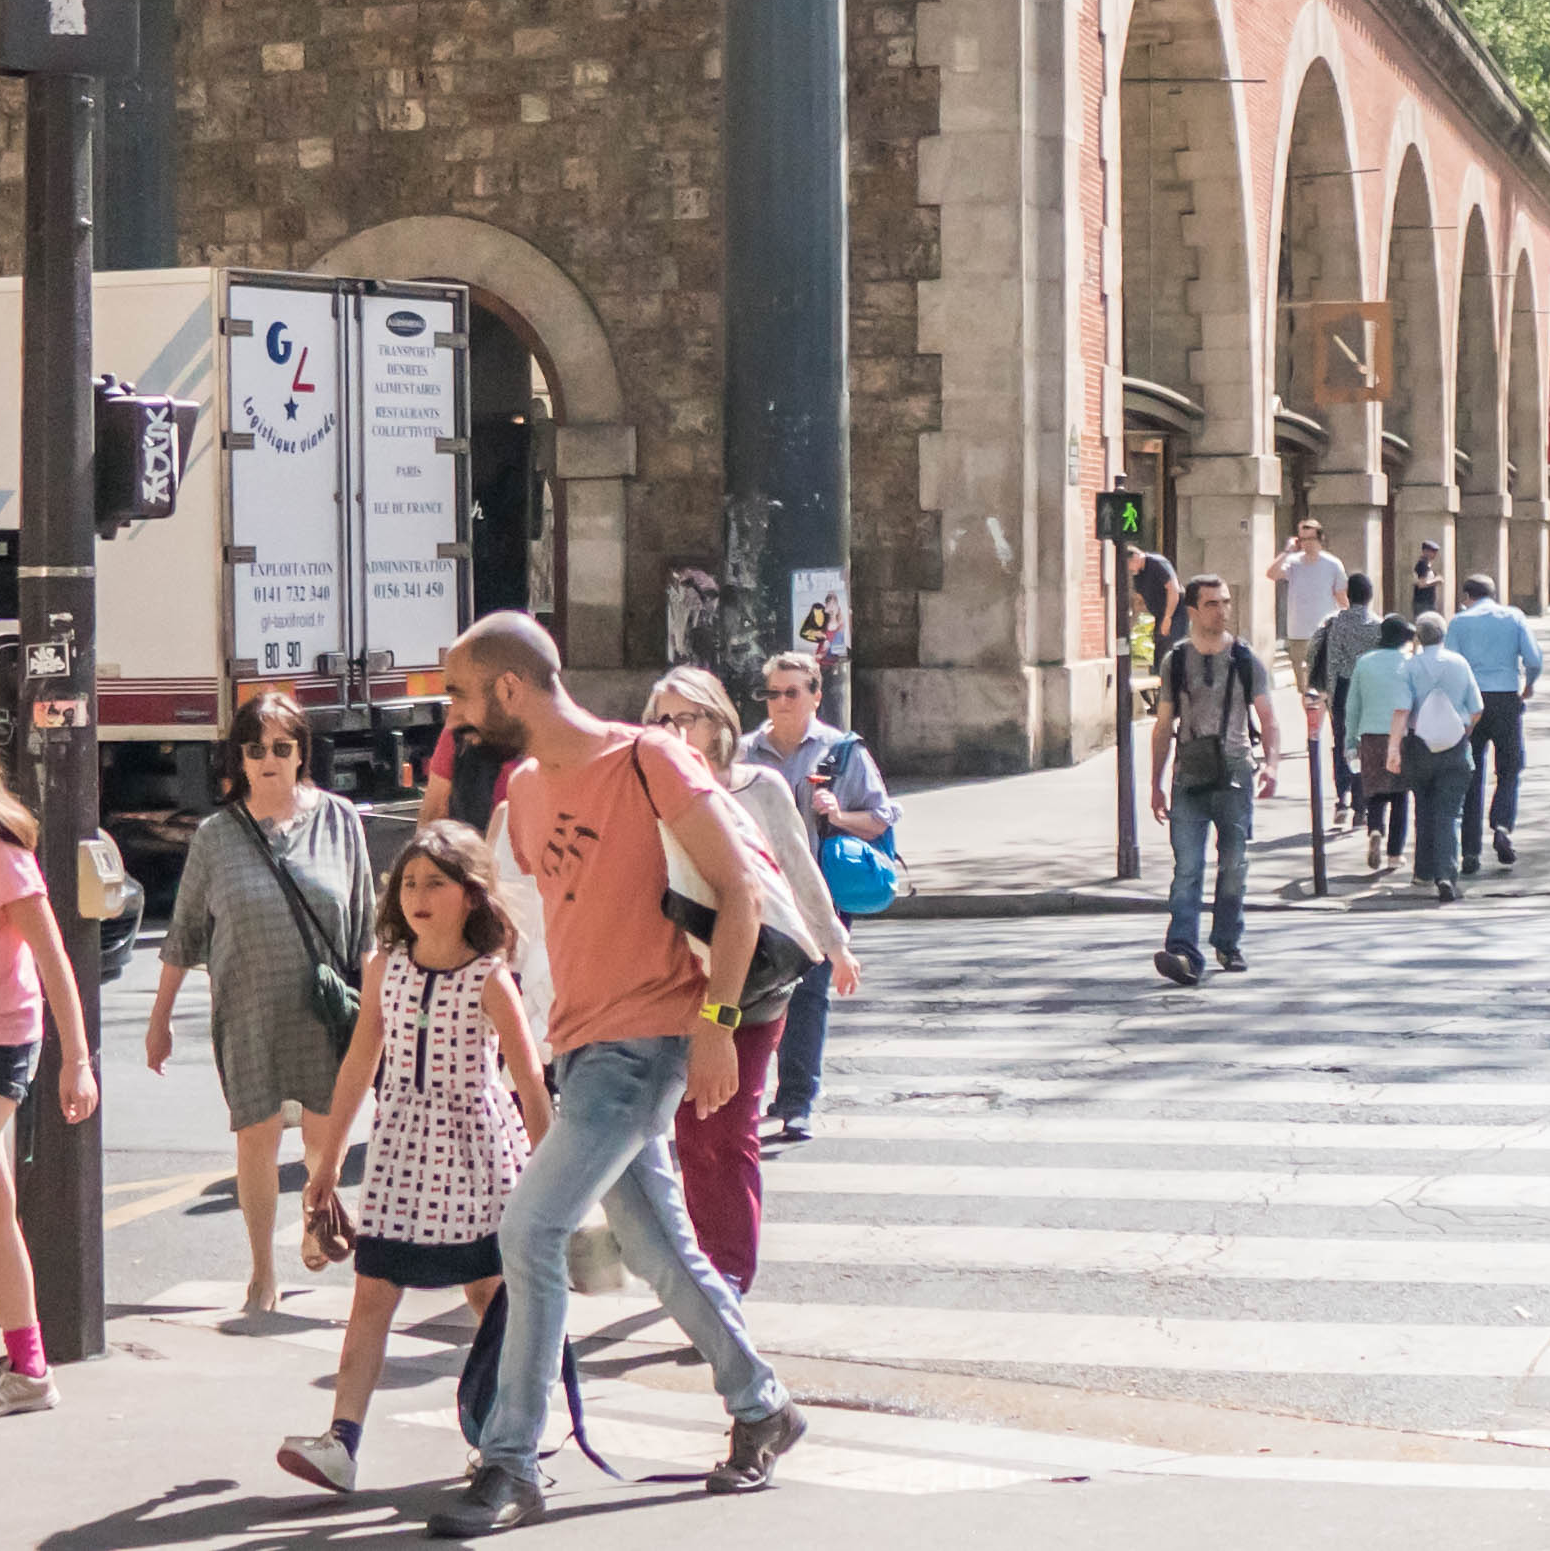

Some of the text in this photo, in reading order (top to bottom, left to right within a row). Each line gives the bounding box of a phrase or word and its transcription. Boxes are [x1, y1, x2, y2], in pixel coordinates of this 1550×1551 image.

[377, 344, 437, 358] TRANSPORTS
[375, 381, 442, 395] ALIMENTAIRES
[375, 406, 440, 419] RESTAURANTS
[396, 466, 422, 477] PARIS
[392, 502, 404, 515] DE
[407, 502, 443, 515] FRANCE
[250, 562, 333, 577] EXPLOITATION
[364, 560, 453, 574] ADMINISTRATION
[254, 586, 281, 603] 0141
[286, 586, 306, 602] 732
[265, 641, 302, 669] 80 90
